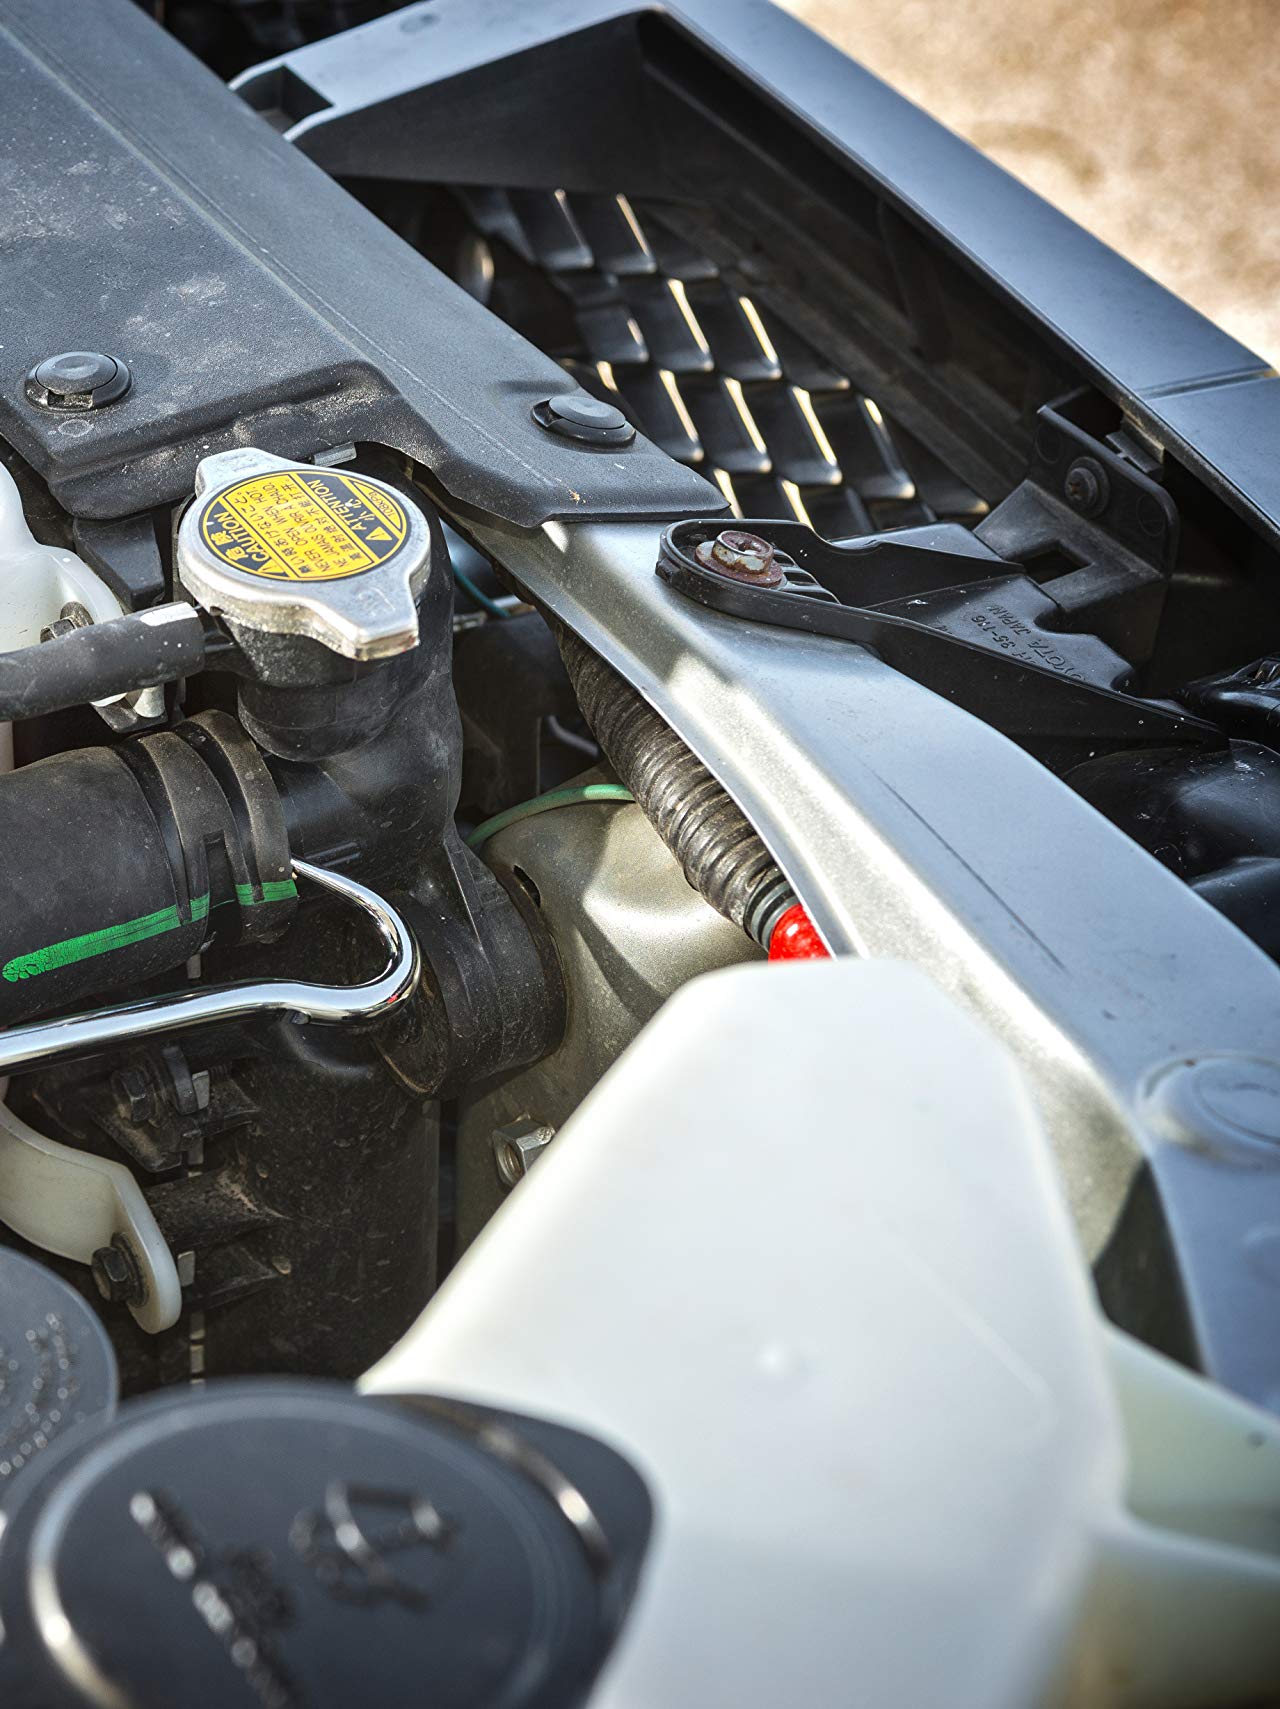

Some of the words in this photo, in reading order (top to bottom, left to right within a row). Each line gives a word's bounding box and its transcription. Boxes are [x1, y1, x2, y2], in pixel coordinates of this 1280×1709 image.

[246, 486, 267, 504] HOT.
[307, 479, 367, 530] ATTENTION
[368, 491, 395, 517] 108kPa
[264, 505, 288, 525] WHEN
[345, 498, 375, 521] 小心
[289, 511, 317, 534] OUVRIR
[214, 512, 270, 561] CAUTION
[284, 527, 309, 546] OPEN
[311, 534, 340, 556] JAMAIS
[304, 548, 330, 572] NEVER
[333, 557, 348, 568] NE
[986, 604, 1032, 635] JAPAN
[1028, 638, 1086, 681] YOTA
